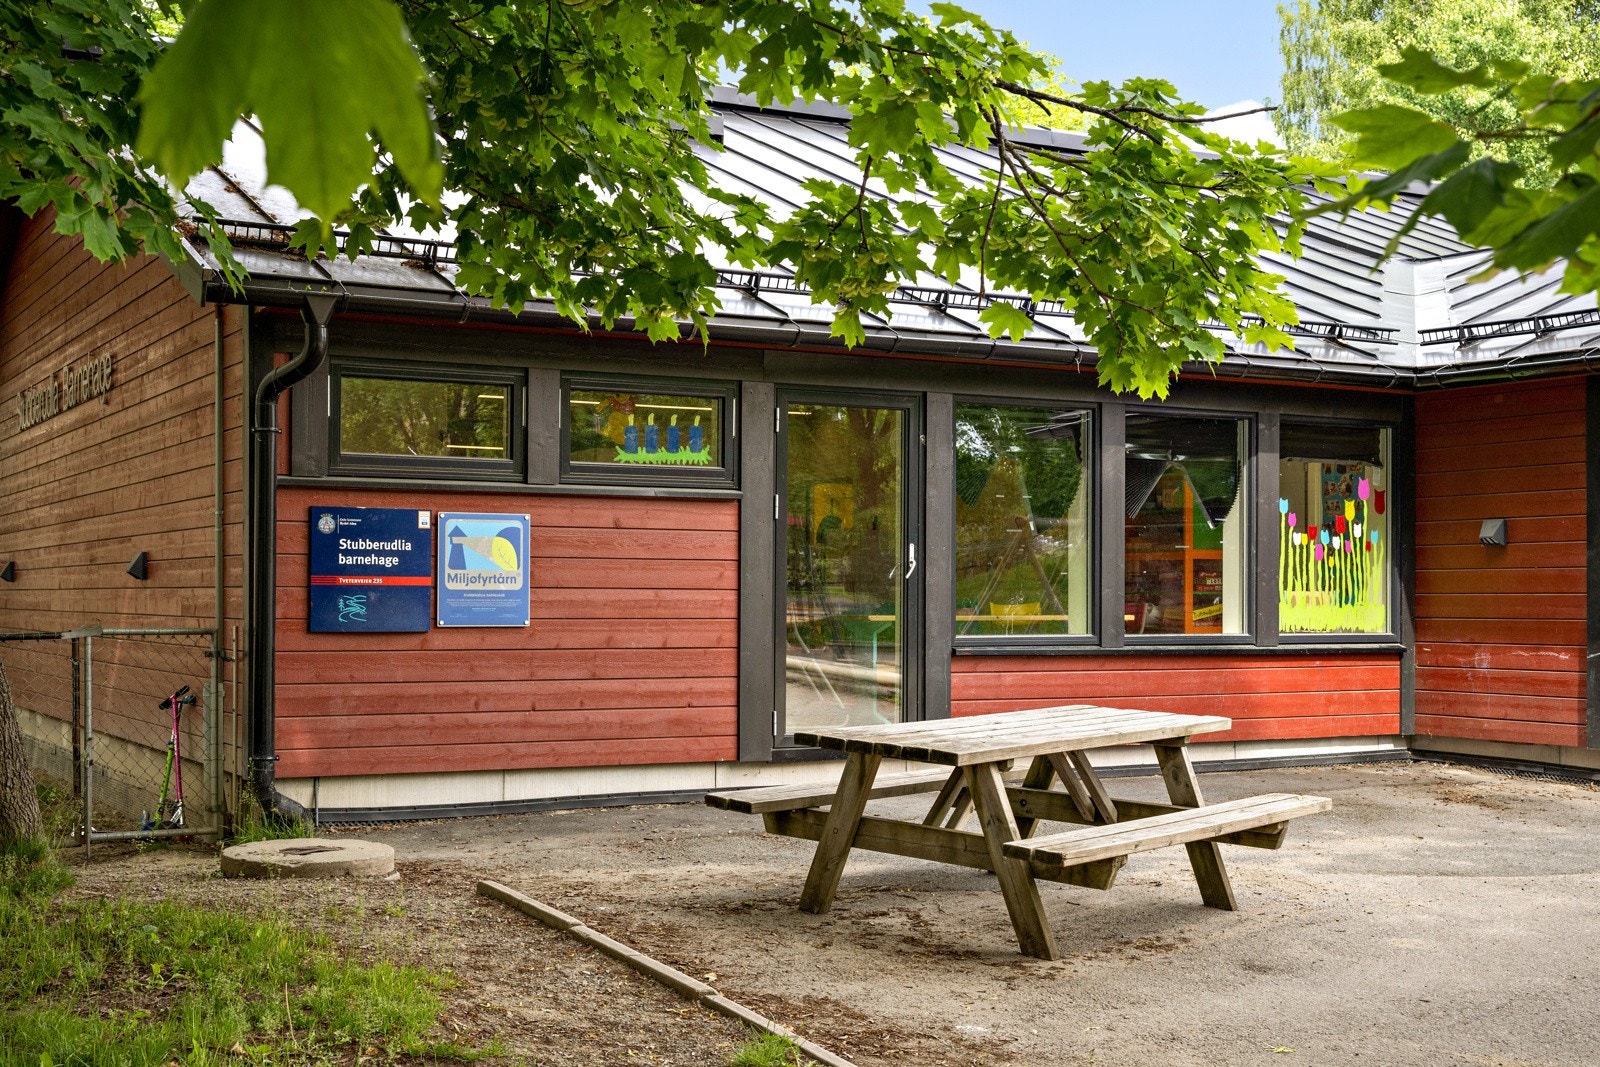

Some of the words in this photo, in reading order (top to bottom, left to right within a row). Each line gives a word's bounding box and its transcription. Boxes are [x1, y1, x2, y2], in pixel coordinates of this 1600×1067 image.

[63, 351, 112, 411] Barnehage
[339, 538, 412, 551] Stubberudlia
[338, 553, 399, 567] barnehage
[447, 572, 517, 587] Miljøfyrtårn
